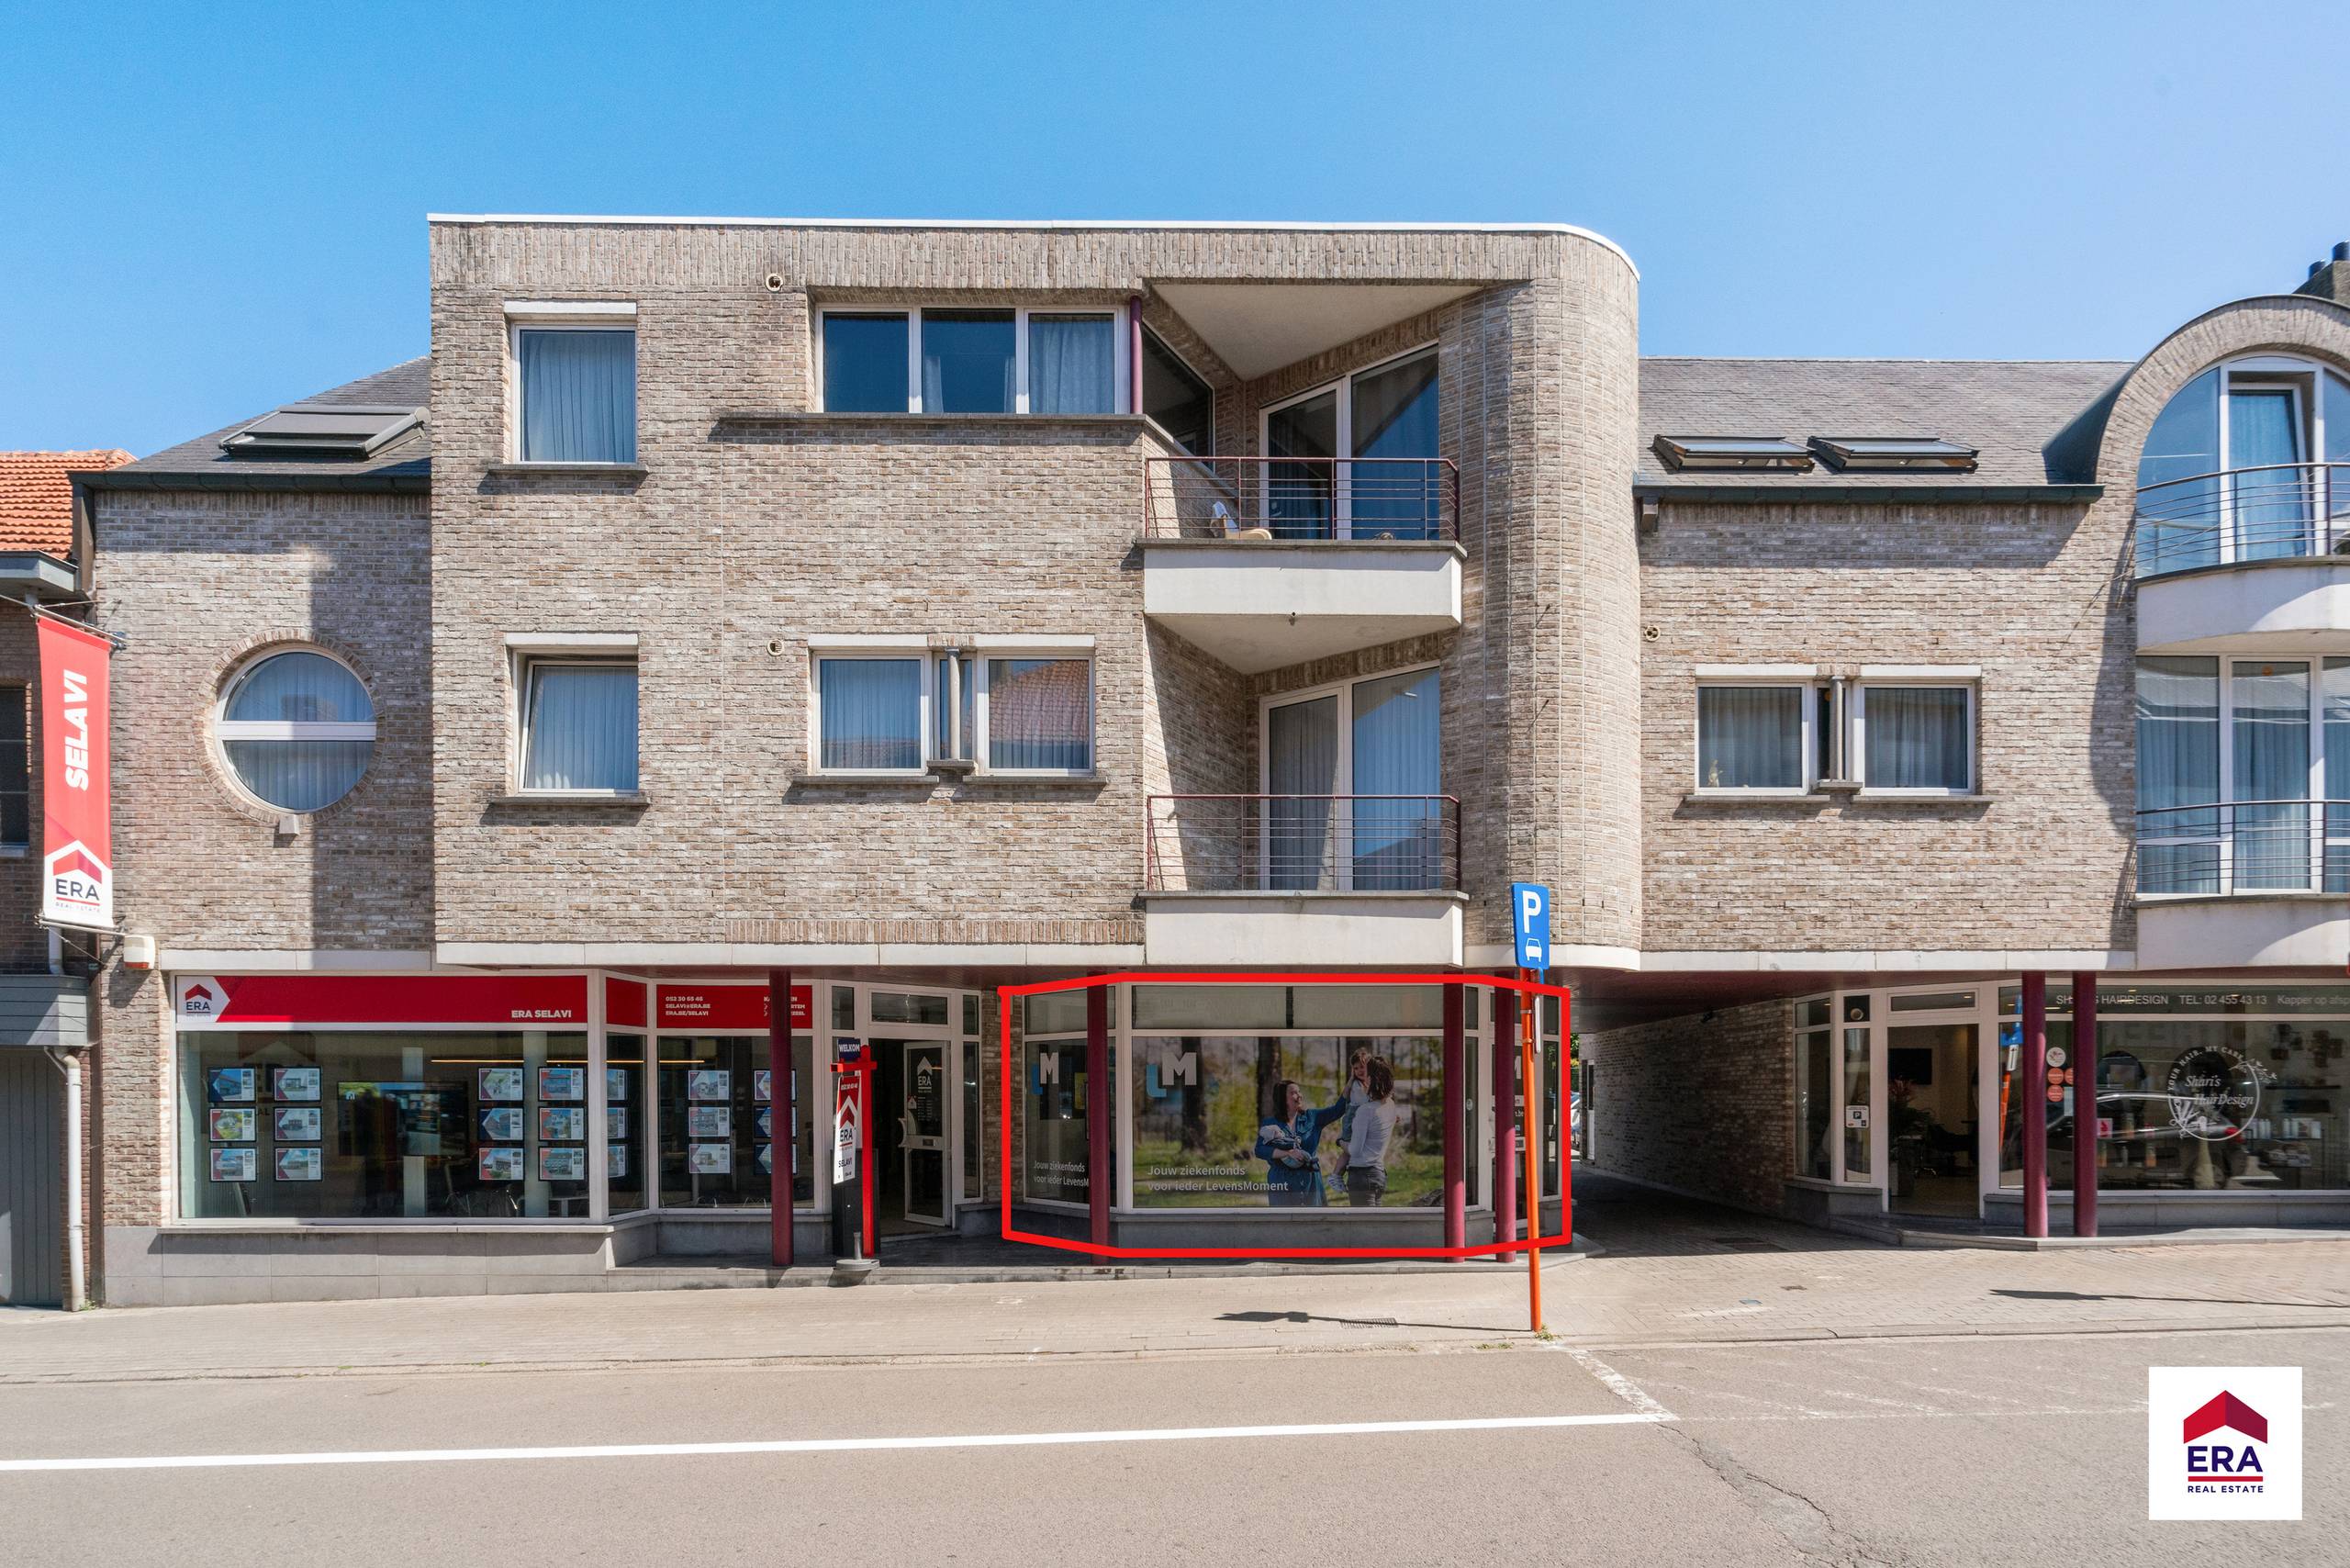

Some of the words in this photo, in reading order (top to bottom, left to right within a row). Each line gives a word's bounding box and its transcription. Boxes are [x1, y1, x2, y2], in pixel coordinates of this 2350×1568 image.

[63, 669, 89, 792] SELAVI
[56, 878, 100, 902] ERA
[1522, 890, 1542, 934] P
[186, 1001, 211, 1011] ERA
[2101, 994, 2169, 1005] HAIRDESIGN
[2178, 994, 2202, 1005] TEL:
[2204, 994, 2218, 1005] 02
[2218, 994, 2238, 1005] 455
[2240, 994, 2253, 1005] 43
[2256, 994, 2267, 1005] 13
[2277, 994, 2313, 1007] Kapper
[2314, 996, 2328, 1007] op
[511, 1009, 532, 1018] ERA
[534, 1009, 572, 1018] SELAVI
[838, 1044, 860, 1053] WELKOM
[918, 1075, 932, 1086] ERA
[2167, 1068, 2181, 1091] YOUR
[2185, 1074, 2221, 1087] Shari's
[839, 1128, 854, 1142] ERA
[1034, 1159, 1048, 1170] Jouw
[1049, 1160, 1085, 1172] ziekenfonds
[1147, 1165, 1177, 1176] Jouw
[1180, 1164, 1246, 1176] ziekenfonds
[1034, 1175, 1046, 1183] voor
[1047, 1175, 1062, 1184] ieder
[1147, 1182, 1172, 1192] voor
[1175, 1181, 1202, 1192] ieder
[1205, 1181, 1289, 1192] LevensMoment
